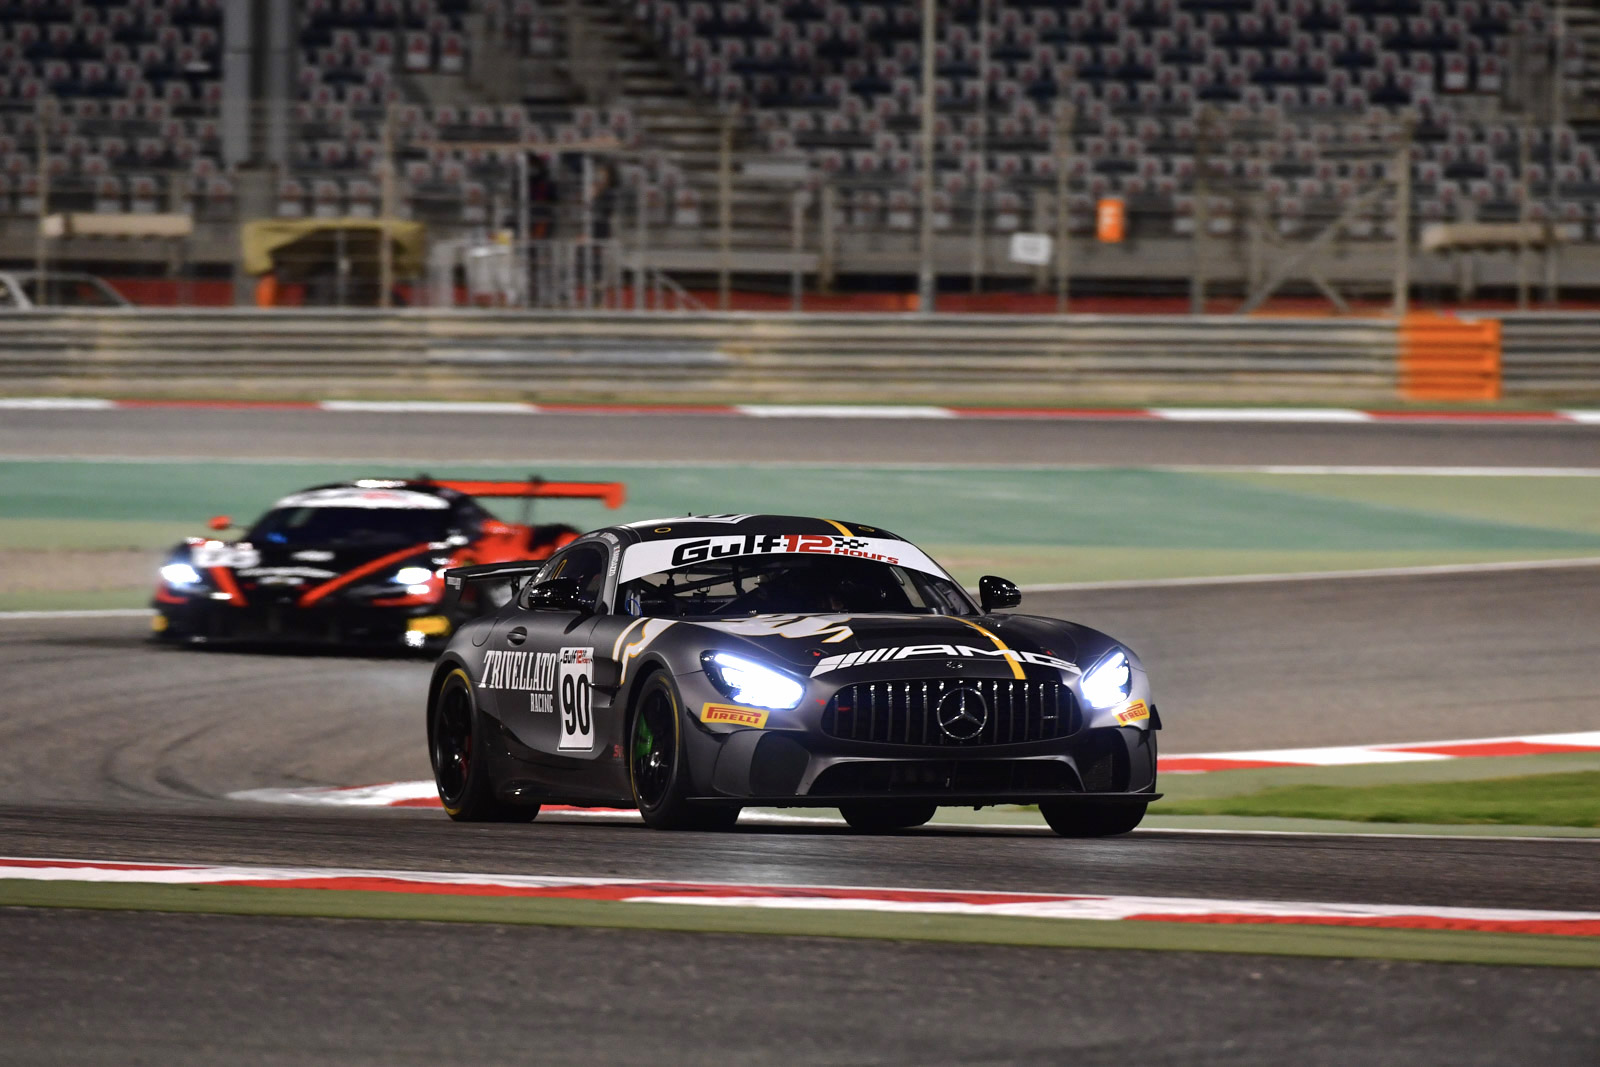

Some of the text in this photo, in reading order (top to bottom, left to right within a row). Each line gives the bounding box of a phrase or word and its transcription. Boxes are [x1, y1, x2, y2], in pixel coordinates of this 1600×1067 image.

[671, 535, 899, 566] Gulf 12 Hours
[478, 650, 557, 691] TRIVELLATO
[892, 644, 1082, 675] AMG
[530, 693, 553, 713] RACING
[562, 674, 590, 736] 90
[706, 706, 762, 724] PIRELLI
